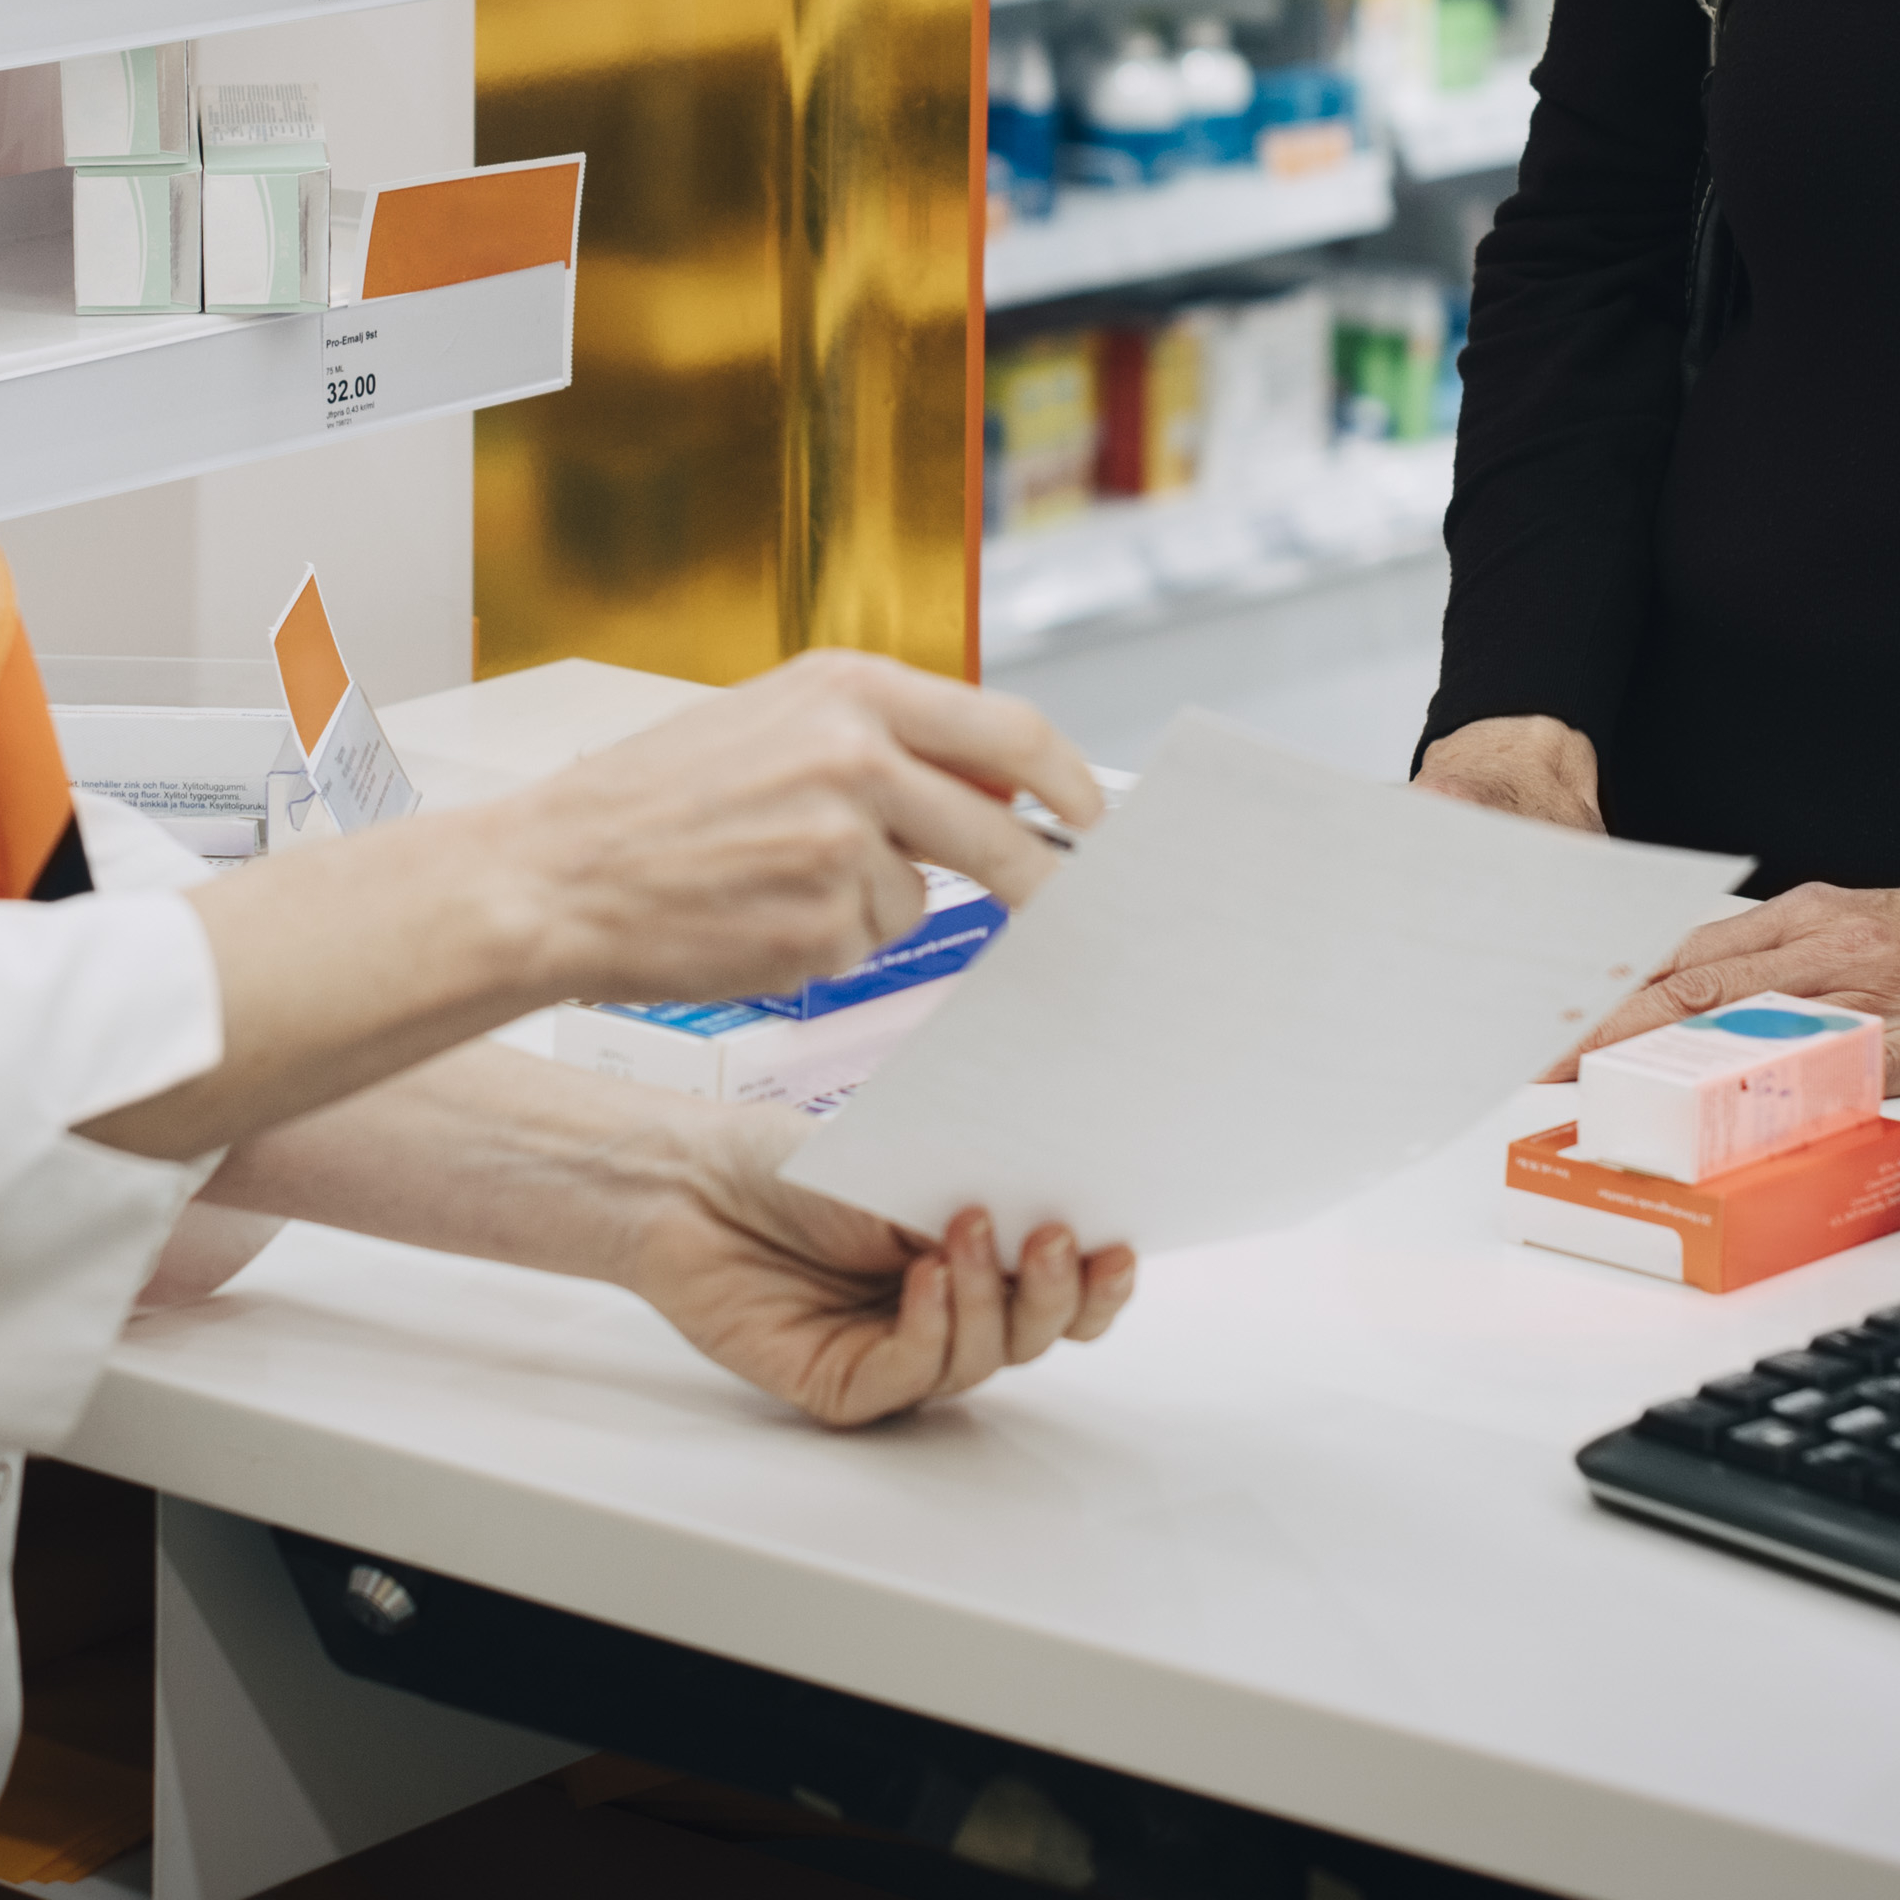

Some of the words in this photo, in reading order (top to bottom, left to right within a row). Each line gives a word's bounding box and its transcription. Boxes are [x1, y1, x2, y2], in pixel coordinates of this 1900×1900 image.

[326, 332, 364, 349] Pro-Emalj
[365, 330, 378, 340] 9st
[326, 366, 334, 376] 75
[334, 365, 344, 374] ML
[326, 373, 376, 404] 32.00
[326, 408, 345, 420] Jfrpris
[81, 780, 122, 789] Innehåller
[123, 780, 141, 790] zink
[142, 781, 158, 790] och
[159, 781, 181, 790] fluor.
[182, 781, 249, 795] Xylitoltuggummi.
[109, 789, 127, 798] zink
[128, 791, 139, 801] og
[140, 790, 162, 800] fluor.
[163, 791, 188, 802] Xylitol
[189, 791, 242, 803] tyggegummi.
[139, 799, 169, 809] sinkkiä
[169, 800, 178, 810] ja
[179, 800, 208, 810] fluoria.
